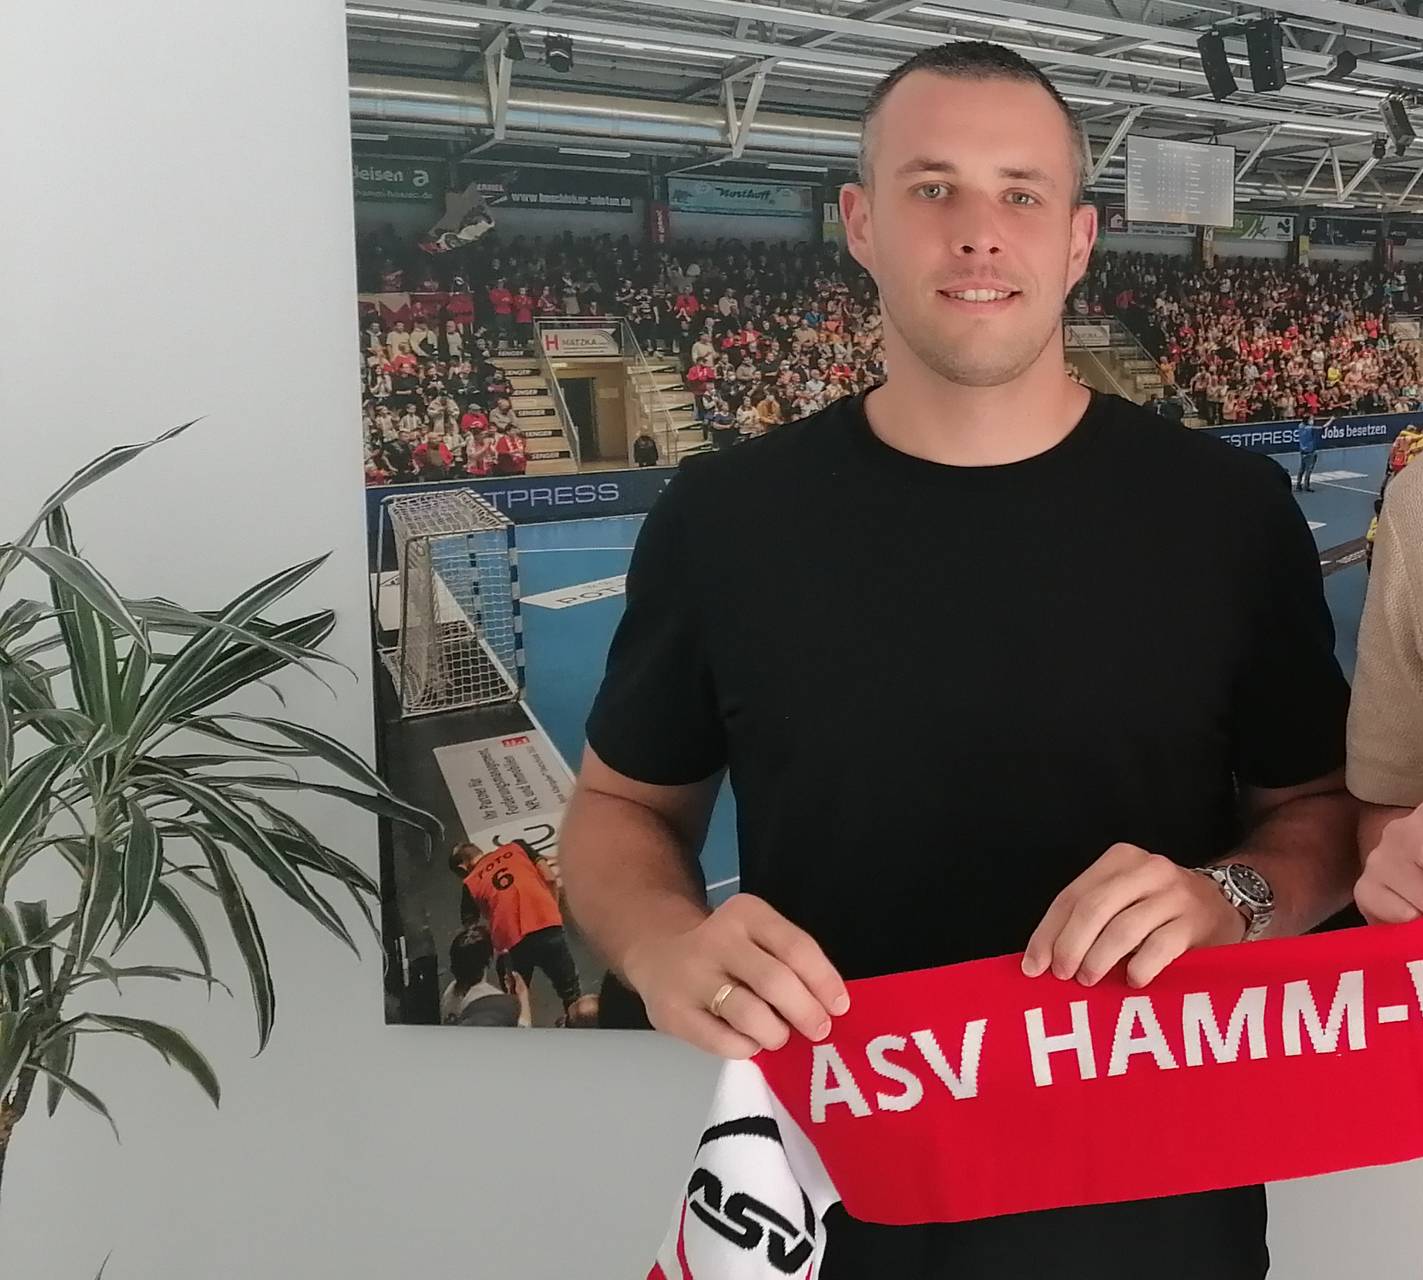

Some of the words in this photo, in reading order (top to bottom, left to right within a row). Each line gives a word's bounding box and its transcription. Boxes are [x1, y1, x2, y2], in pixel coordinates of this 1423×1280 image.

[545, 334, 559, 351] H
[1322, 426, 1344, 439] Jobs
[1346, 424, 1387, 437] besetzen
[483, 483, 619, 509] TPRESS
[492, 867, 514, 890] 6
[809, 1019, 988, 1123] ASV
[688, 1167, 814, 1275] ASV
